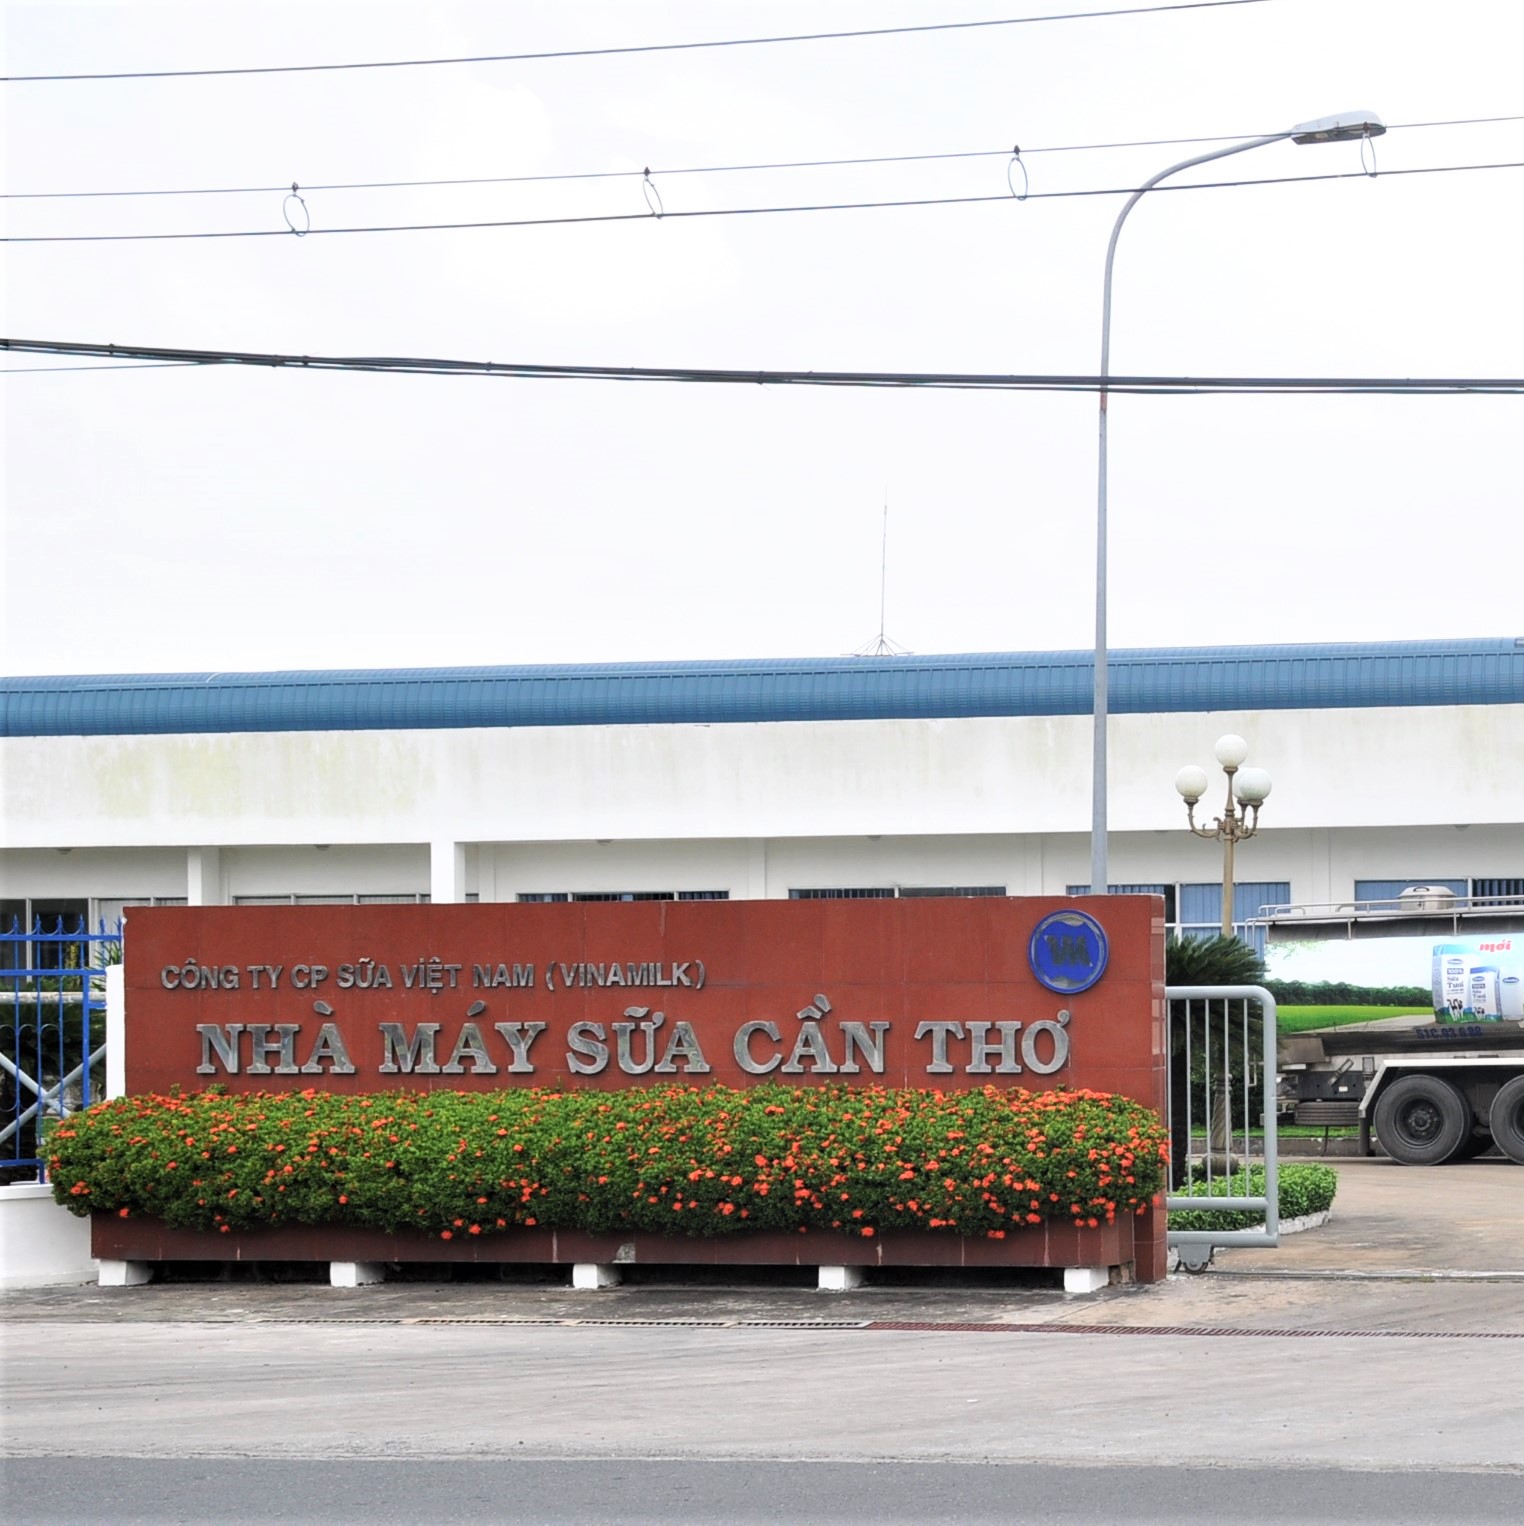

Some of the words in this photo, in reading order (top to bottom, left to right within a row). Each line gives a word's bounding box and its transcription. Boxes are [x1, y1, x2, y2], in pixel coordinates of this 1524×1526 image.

[161, 958, 240, 991] CÔNG
[248, 964, 283, 990] TY
[291, 963, 329, 989] CP
[336, 957, 393, 989] SỮA
[401, 956, 462, 994] VIỆT
[473, 963, 535, 988] NAM
[546, 960, 706, 991] (VINAMILK)
[196, 1000, 356, 1075] NHÀ
[379, 1000, 547, 1075] MÁY
[566, 1005, 711, 1075] SỮA
[733, 993, 891, 1074] CẦN
[914, 1009, 1071, 1075] THƠ
